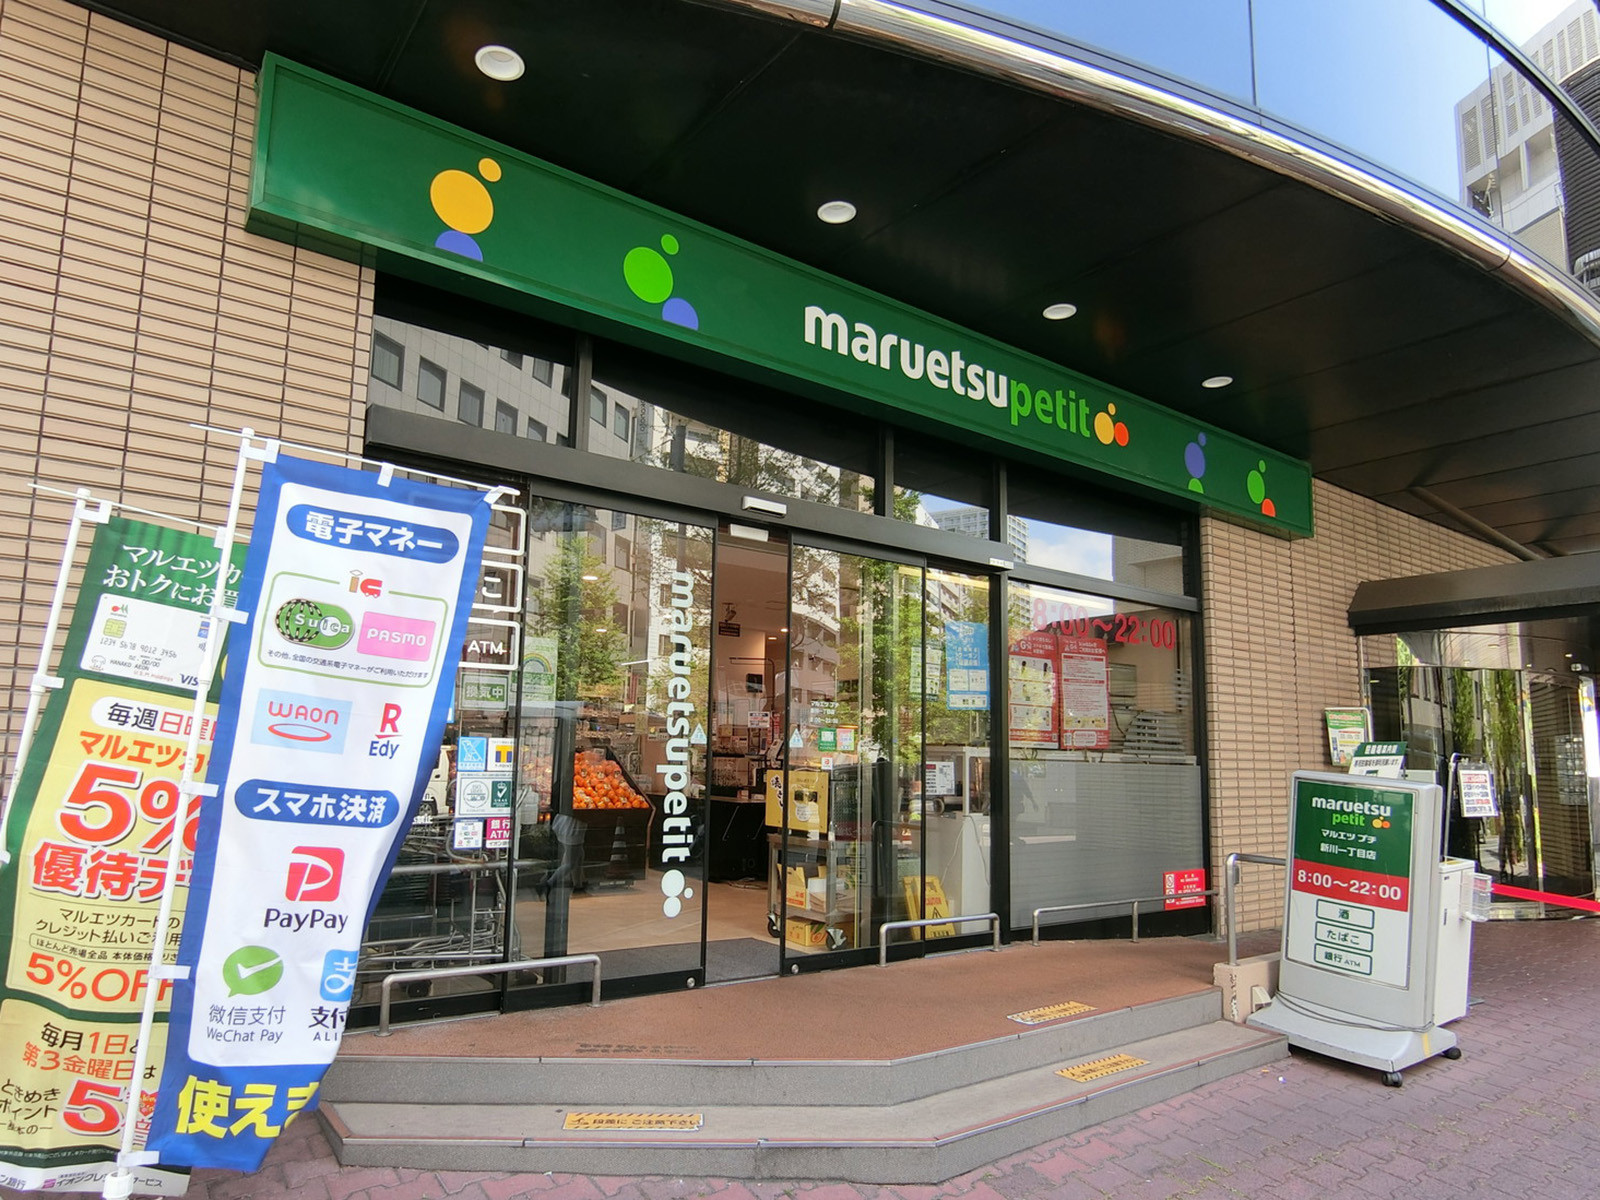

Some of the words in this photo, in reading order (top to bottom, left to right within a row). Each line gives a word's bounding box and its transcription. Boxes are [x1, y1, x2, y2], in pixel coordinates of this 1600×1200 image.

[305, 511, 444, 552] 電子マネー
[122, 544, 243, 585] マルエツカ
[294, 612, 350, 635] Suica
[367, 627, 427, 647] PASMO
[467, 640, 503, 656] ATM
[107, 702, 218, 741] 毎週日曜
[268, 701, 340, 725] WAON
[379, 702, 403, 733] R
[79, 730, 210, 774] マルエツカ
[369, 740, 400, 760] Edy
[60, 763, 203, 852] 5%
[253, 787, 388, 824] スマホ決済
[1311, 796, 1392, 817] maruetsu
[1332, 812, 1366, 827] petit
[1320, 828, 1356, 841] マルエツ
[1357, 833, 1377, 845] プチ
[1319, 842, 1377, 861] 新川一丁目店
[33, 842, 194, 898] 優待デ
[264, 908, 349, 934] PayPay
[1338, 908, 1350, 920] 酒
[1326, 929, 1360, 945] たばこ
[1324, 950, 1343, 964] 銀行
[1344, 958, 1361, 968] ATM
[209, 1004, 286, 1026] 微信支付
[206, 1025, 255, 1043] WeChat
[260, 1028, 284, 1044] Pay
